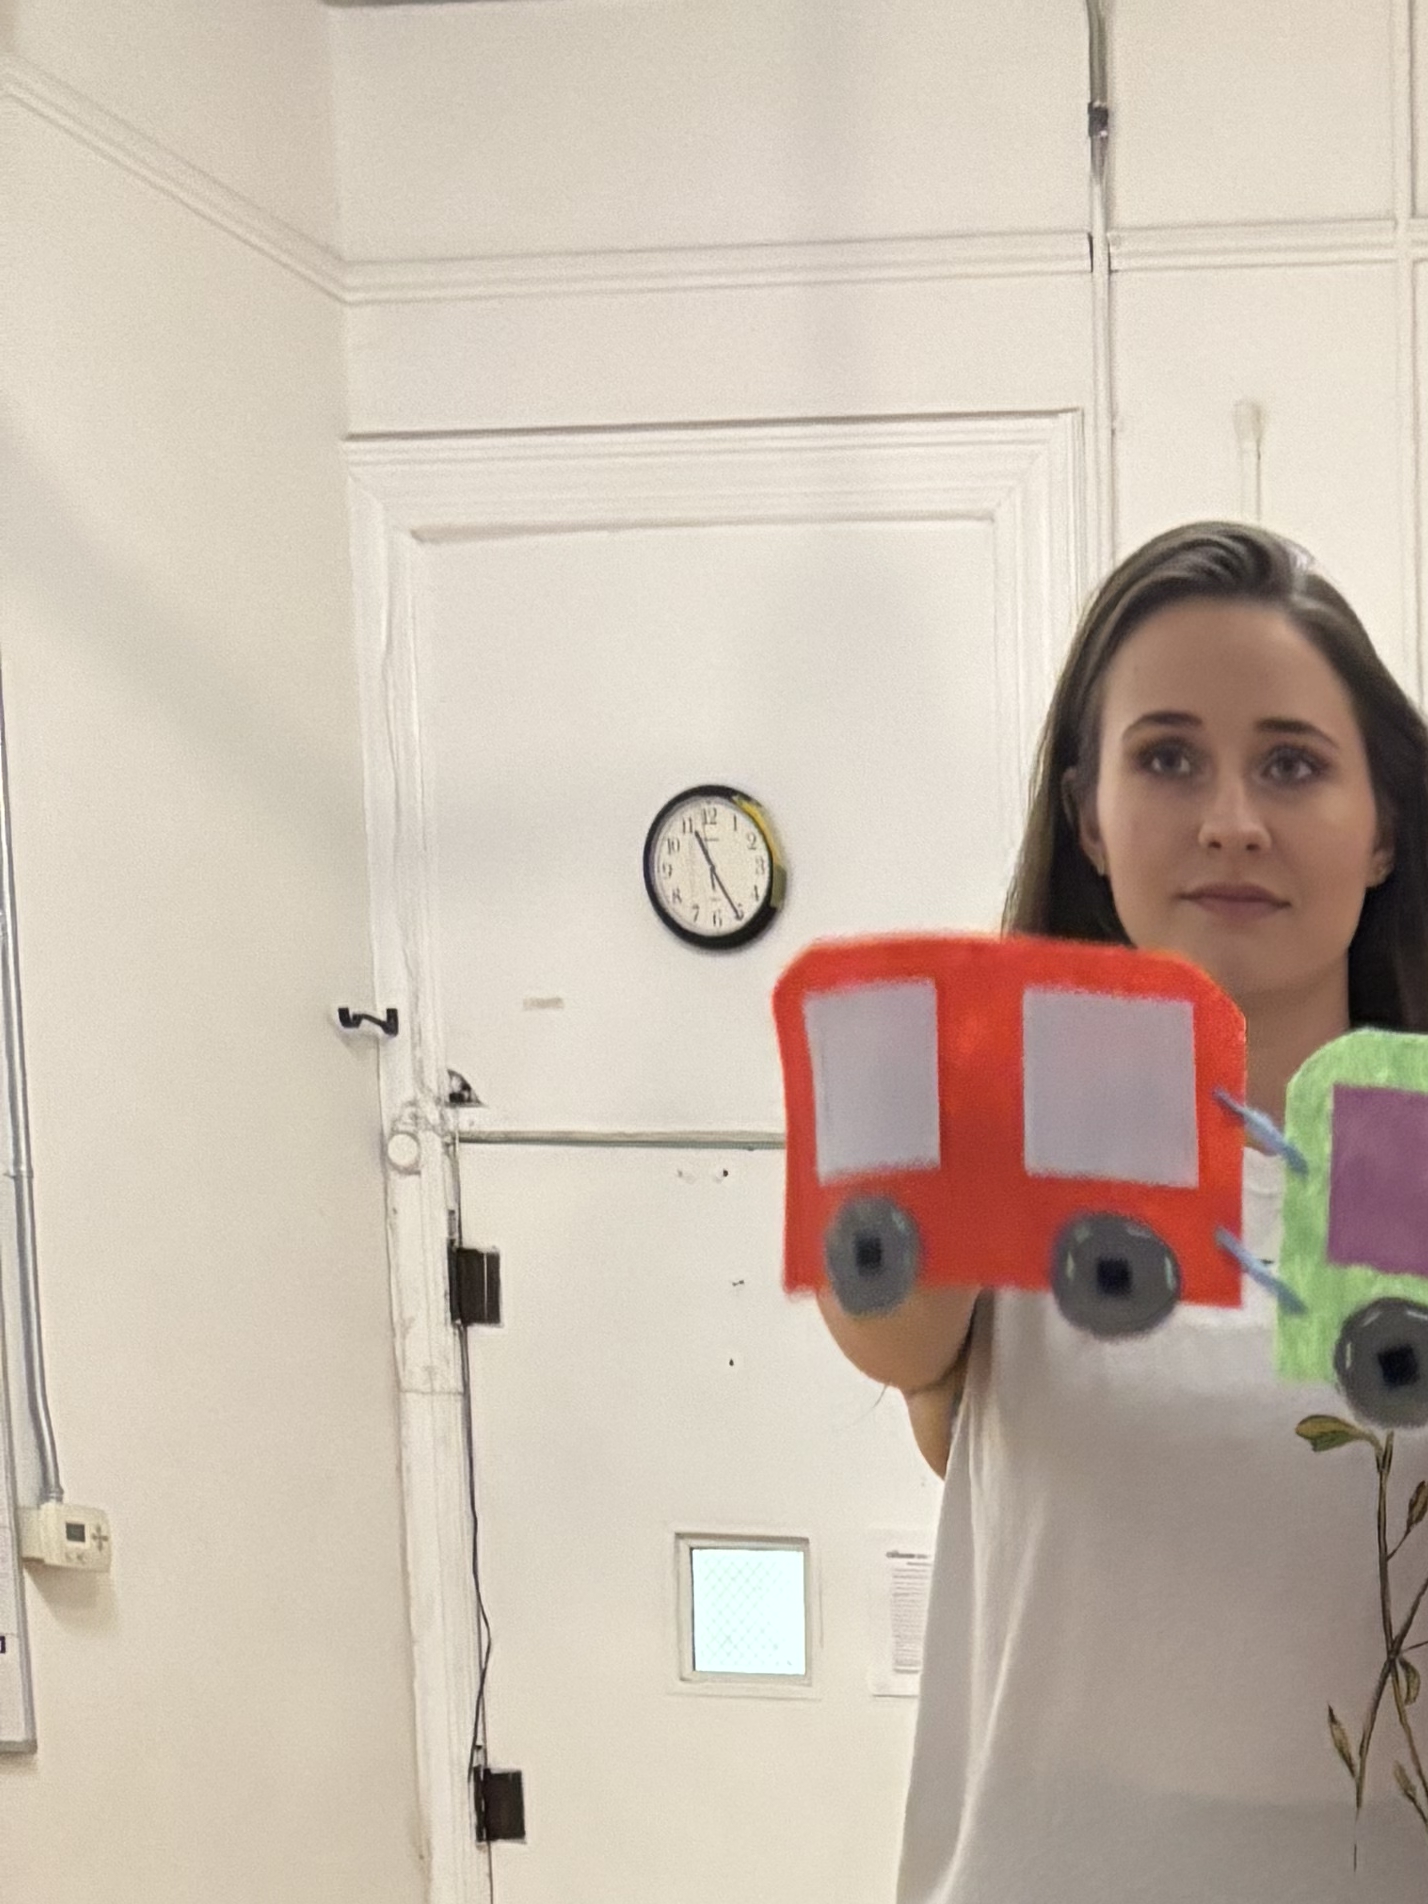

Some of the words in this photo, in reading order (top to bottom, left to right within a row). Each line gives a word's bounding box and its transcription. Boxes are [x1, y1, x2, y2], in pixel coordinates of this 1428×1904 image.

[682, 816, 693, 835] 11
[702, 807, 718, 826] 12
[667, 838, 680, 855] 10
[747, 832, 757, 851] 2
[662, 862, 672, 880] 9
[756, 856, 765, 876] 3
[751, 885, 759, 902] 4
[692, 903, 700, 923] 7
[712, 908, 722, 928] 6
